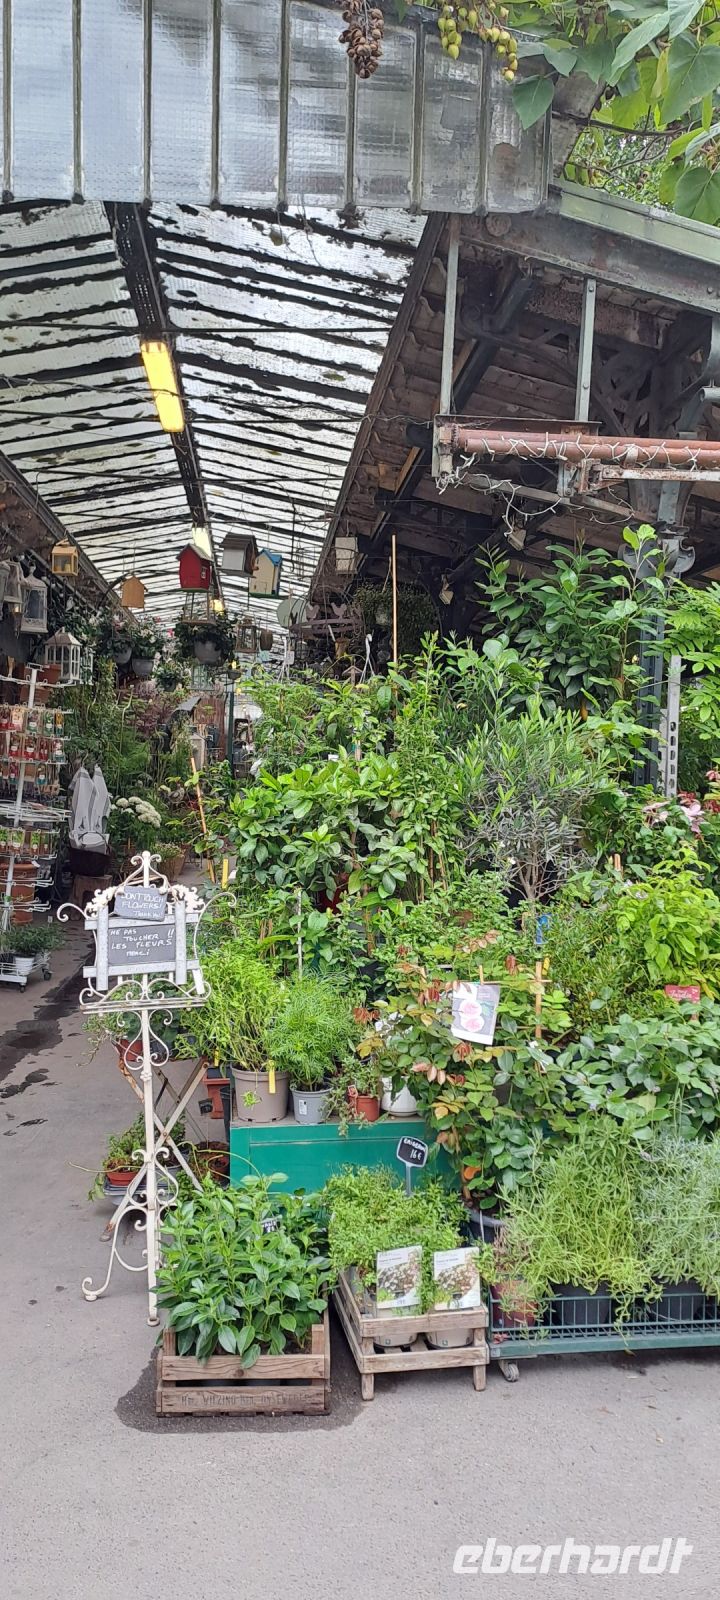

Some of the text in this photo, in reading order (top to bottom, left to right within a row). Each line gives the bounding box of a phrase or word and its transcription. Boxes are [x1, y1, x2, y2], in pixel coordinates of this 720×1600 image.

[123, 928, 137, 936] PAS
[123, 933, 160, 942] TOUCHER
[111, 939, 172, 950] LES FLEURS
